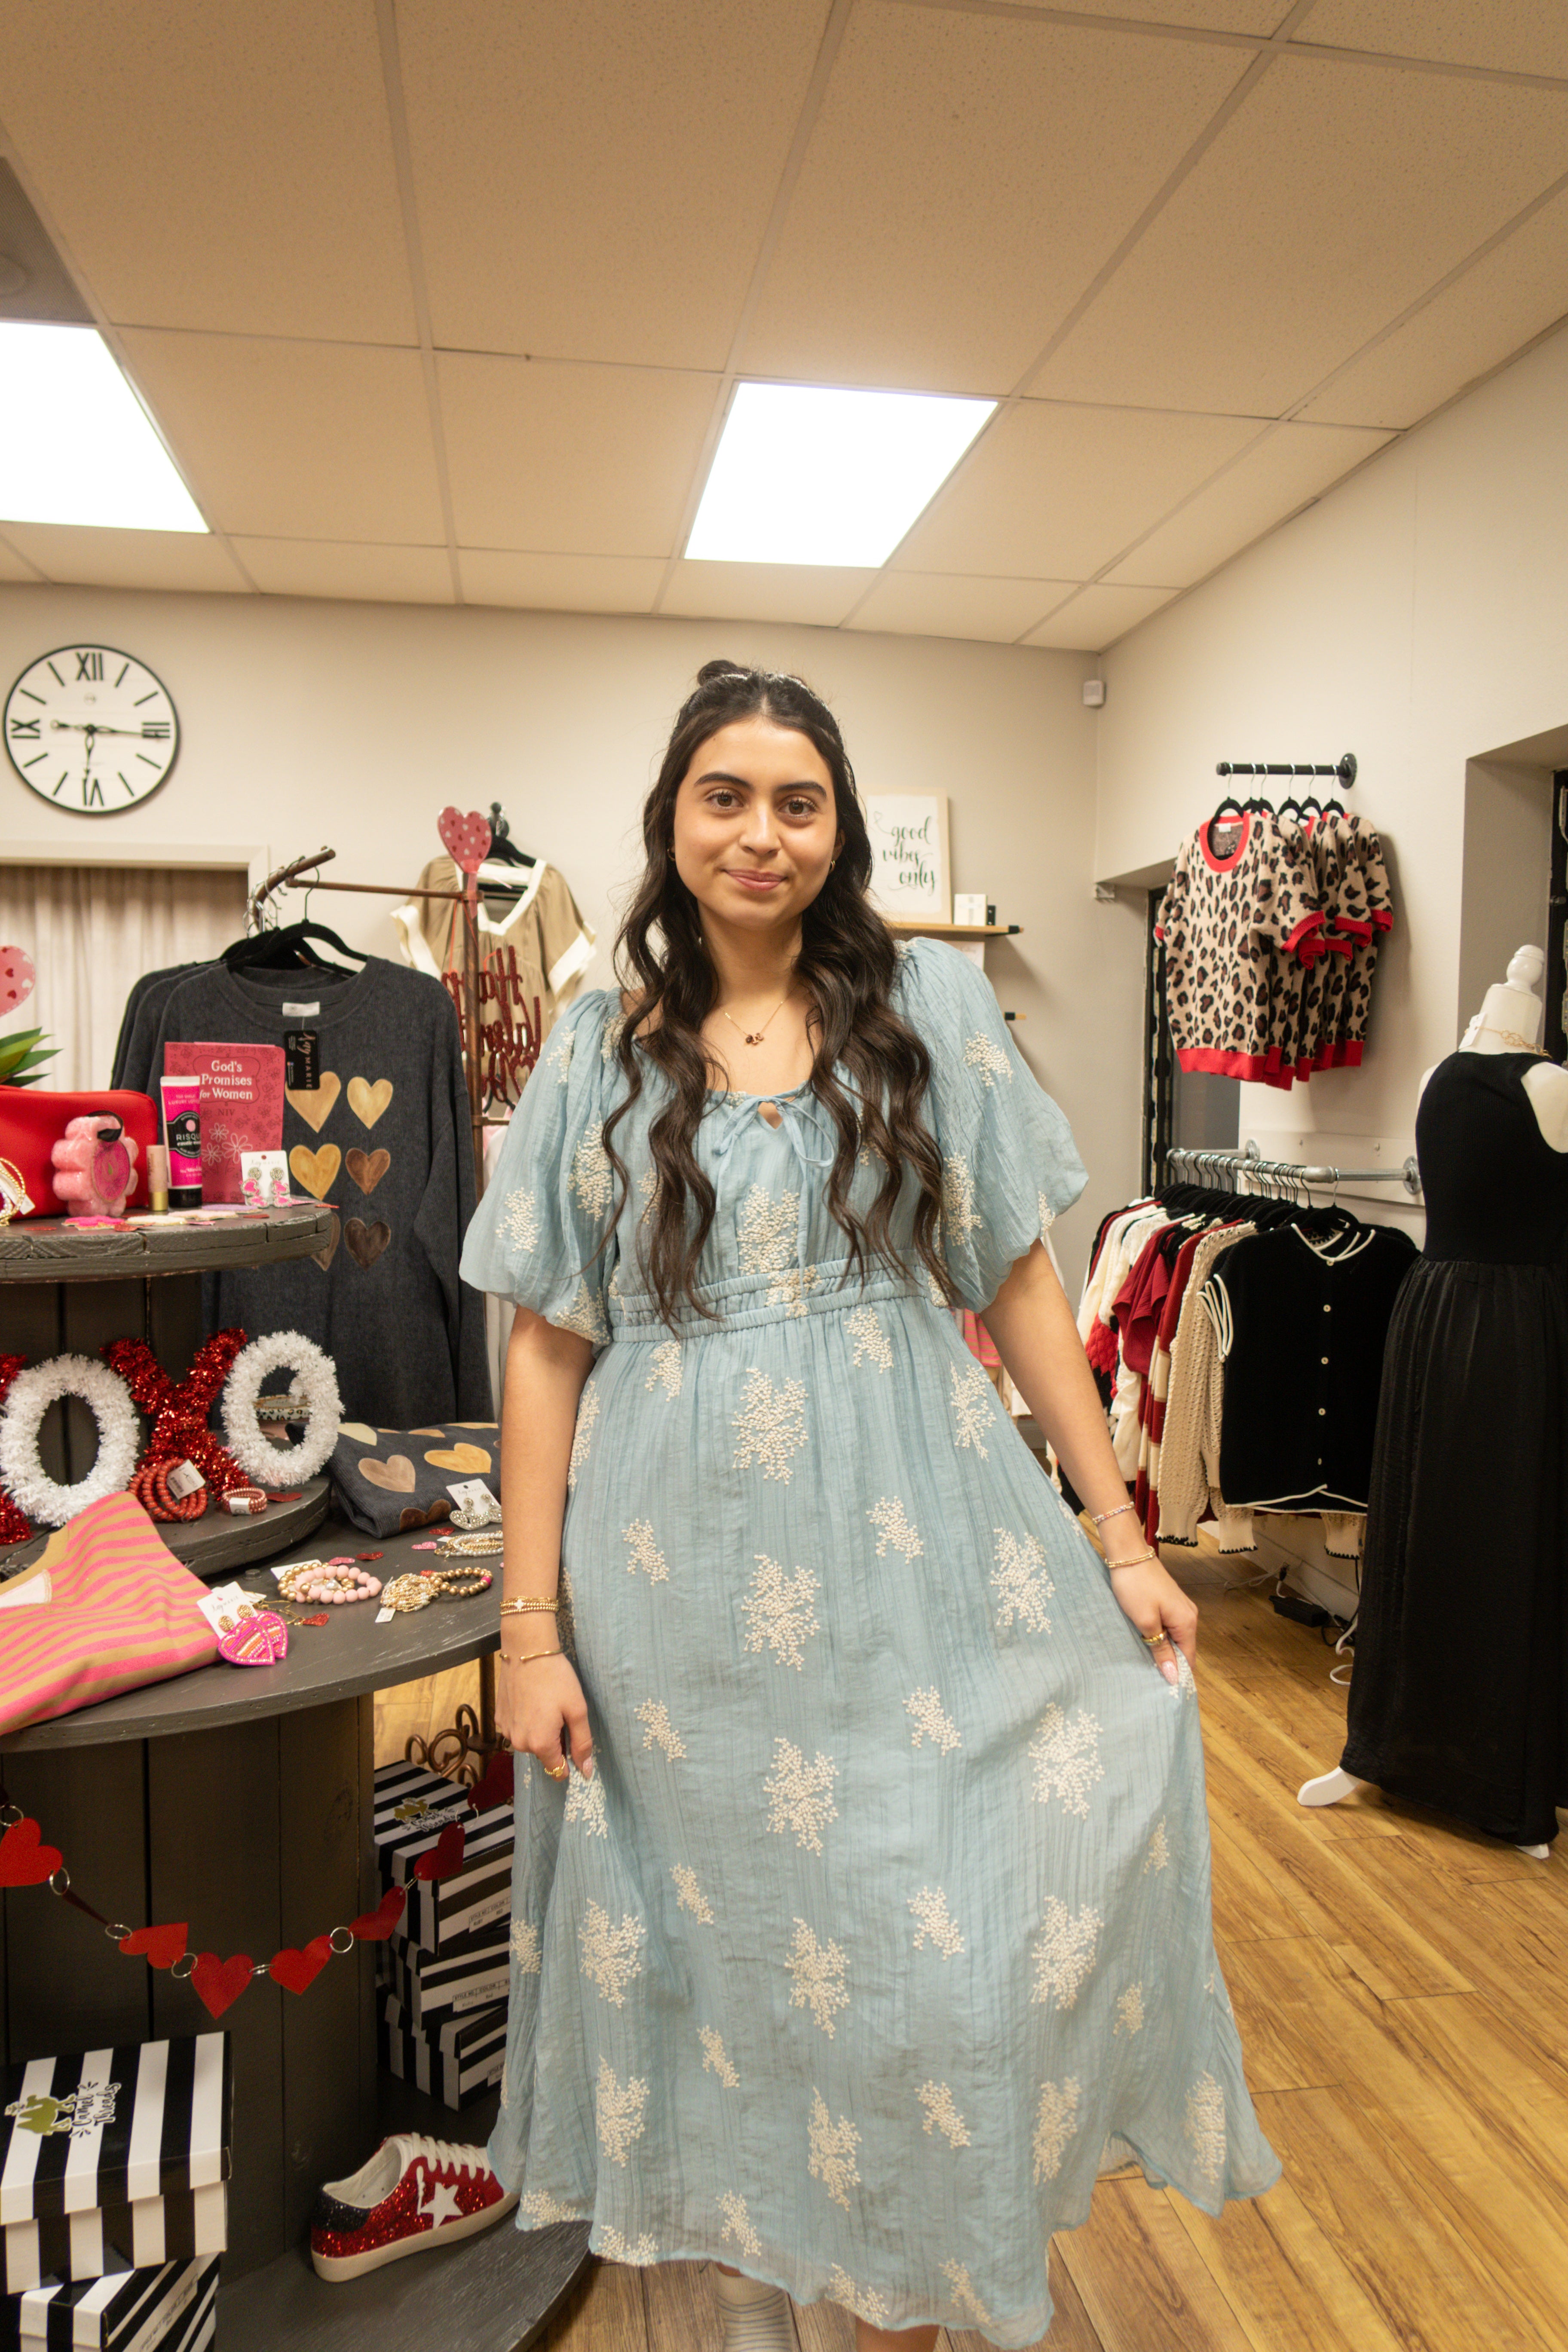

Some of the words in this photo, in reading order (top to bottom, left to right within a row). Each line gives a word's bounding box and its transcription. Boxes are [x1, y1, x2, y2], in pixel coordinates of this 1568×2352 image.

[75, 652, 103, 681] XII
[891, 816, 932, 847] good
[882, 840, 933, 867] vibes
[898, 861, 937, 896] only
[201, 1074, 252, 1086] Promises
[211, 1060, 242, 1072] God's
[199, 1090, 211, 1099] for
[212, 1087, 253, 1100] Women
[176, 1133, 201, 1141] RISQU
[72, 2095, 94, 2126] Camel
[93, 2084, 120, 2126] Threads
